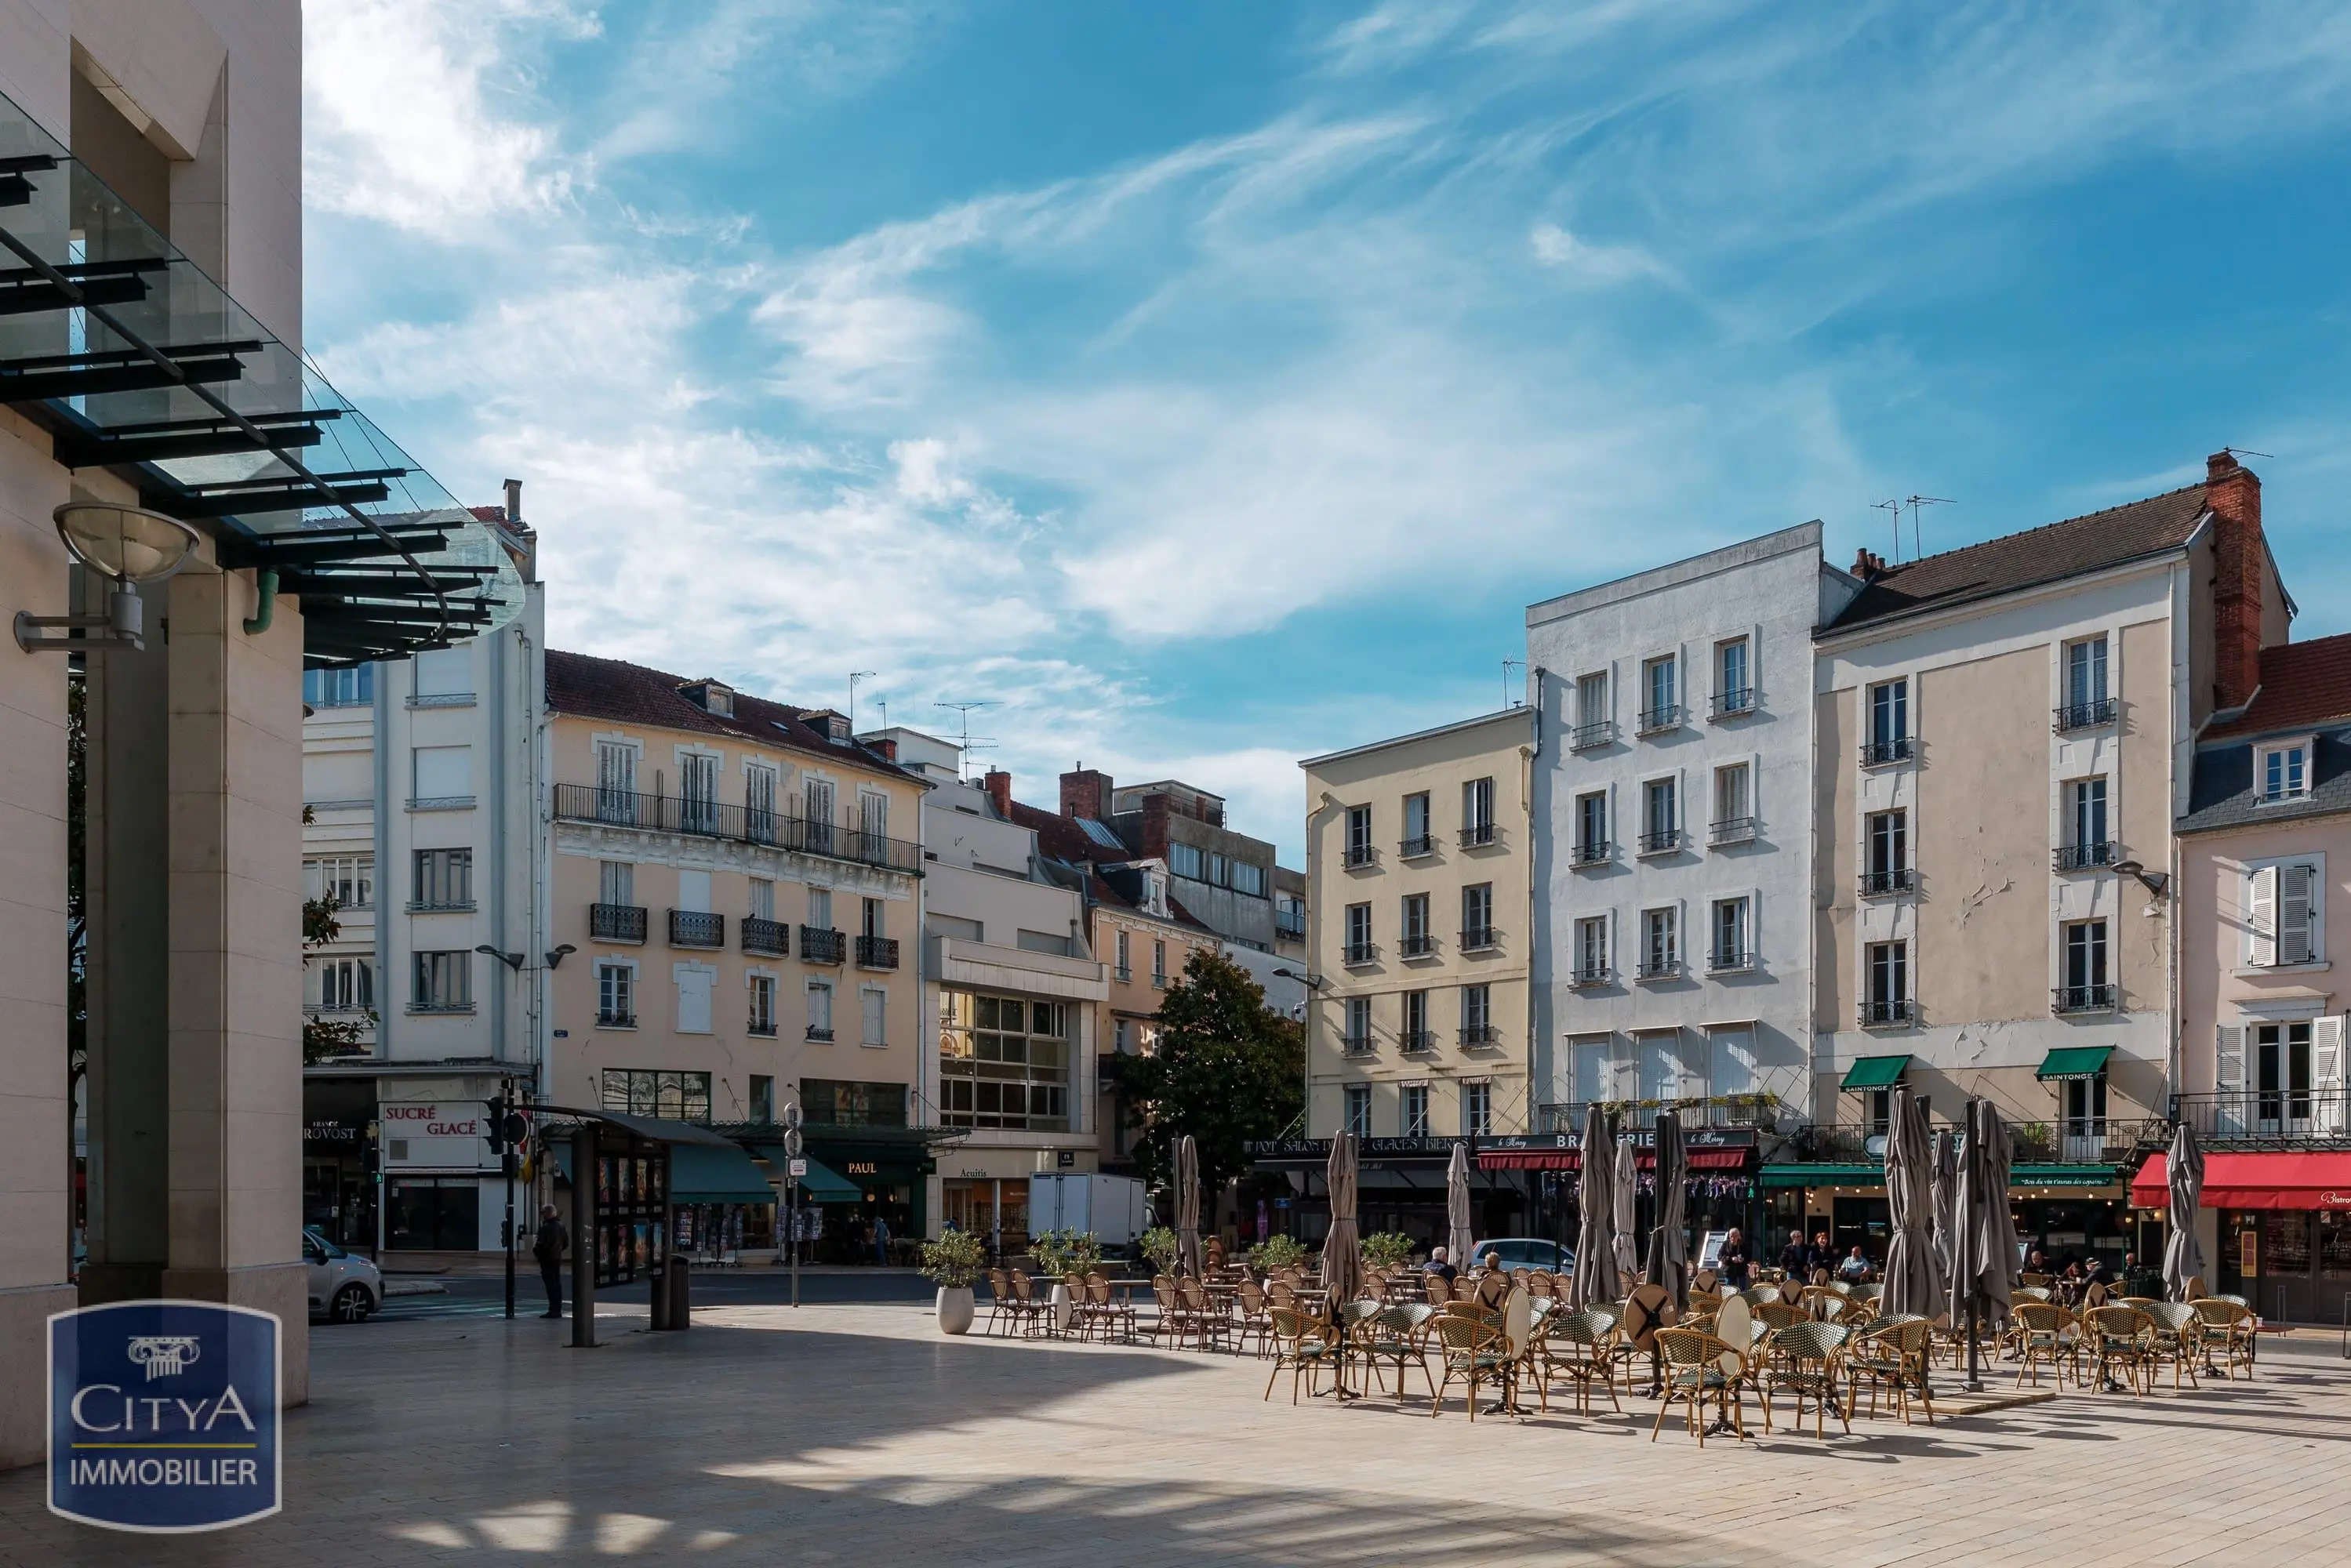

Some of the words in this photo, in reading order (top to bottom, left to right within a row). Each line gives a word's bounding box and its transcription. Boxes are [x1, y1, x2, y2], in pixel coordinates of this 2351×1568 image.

[386, 1105, 436, 1119] SUCRÉ
[303, 1127, 357, 1140] ROVOST
[427, 1120, 477, 1134] GLACÉ
[1255, 1141, 1277, 1152] POT
[1284, 1140, 1320, 1152] SALON
[1372, 1138, 1418, 1151] GLACES
[1557, 1134, 1655, 1148] BRERIE
[848, 1163, 877, 1174] PAUL
[960, 1168, 987, 1177] Acuitis
[2321, 1192, 2351, 1203] Bistro
